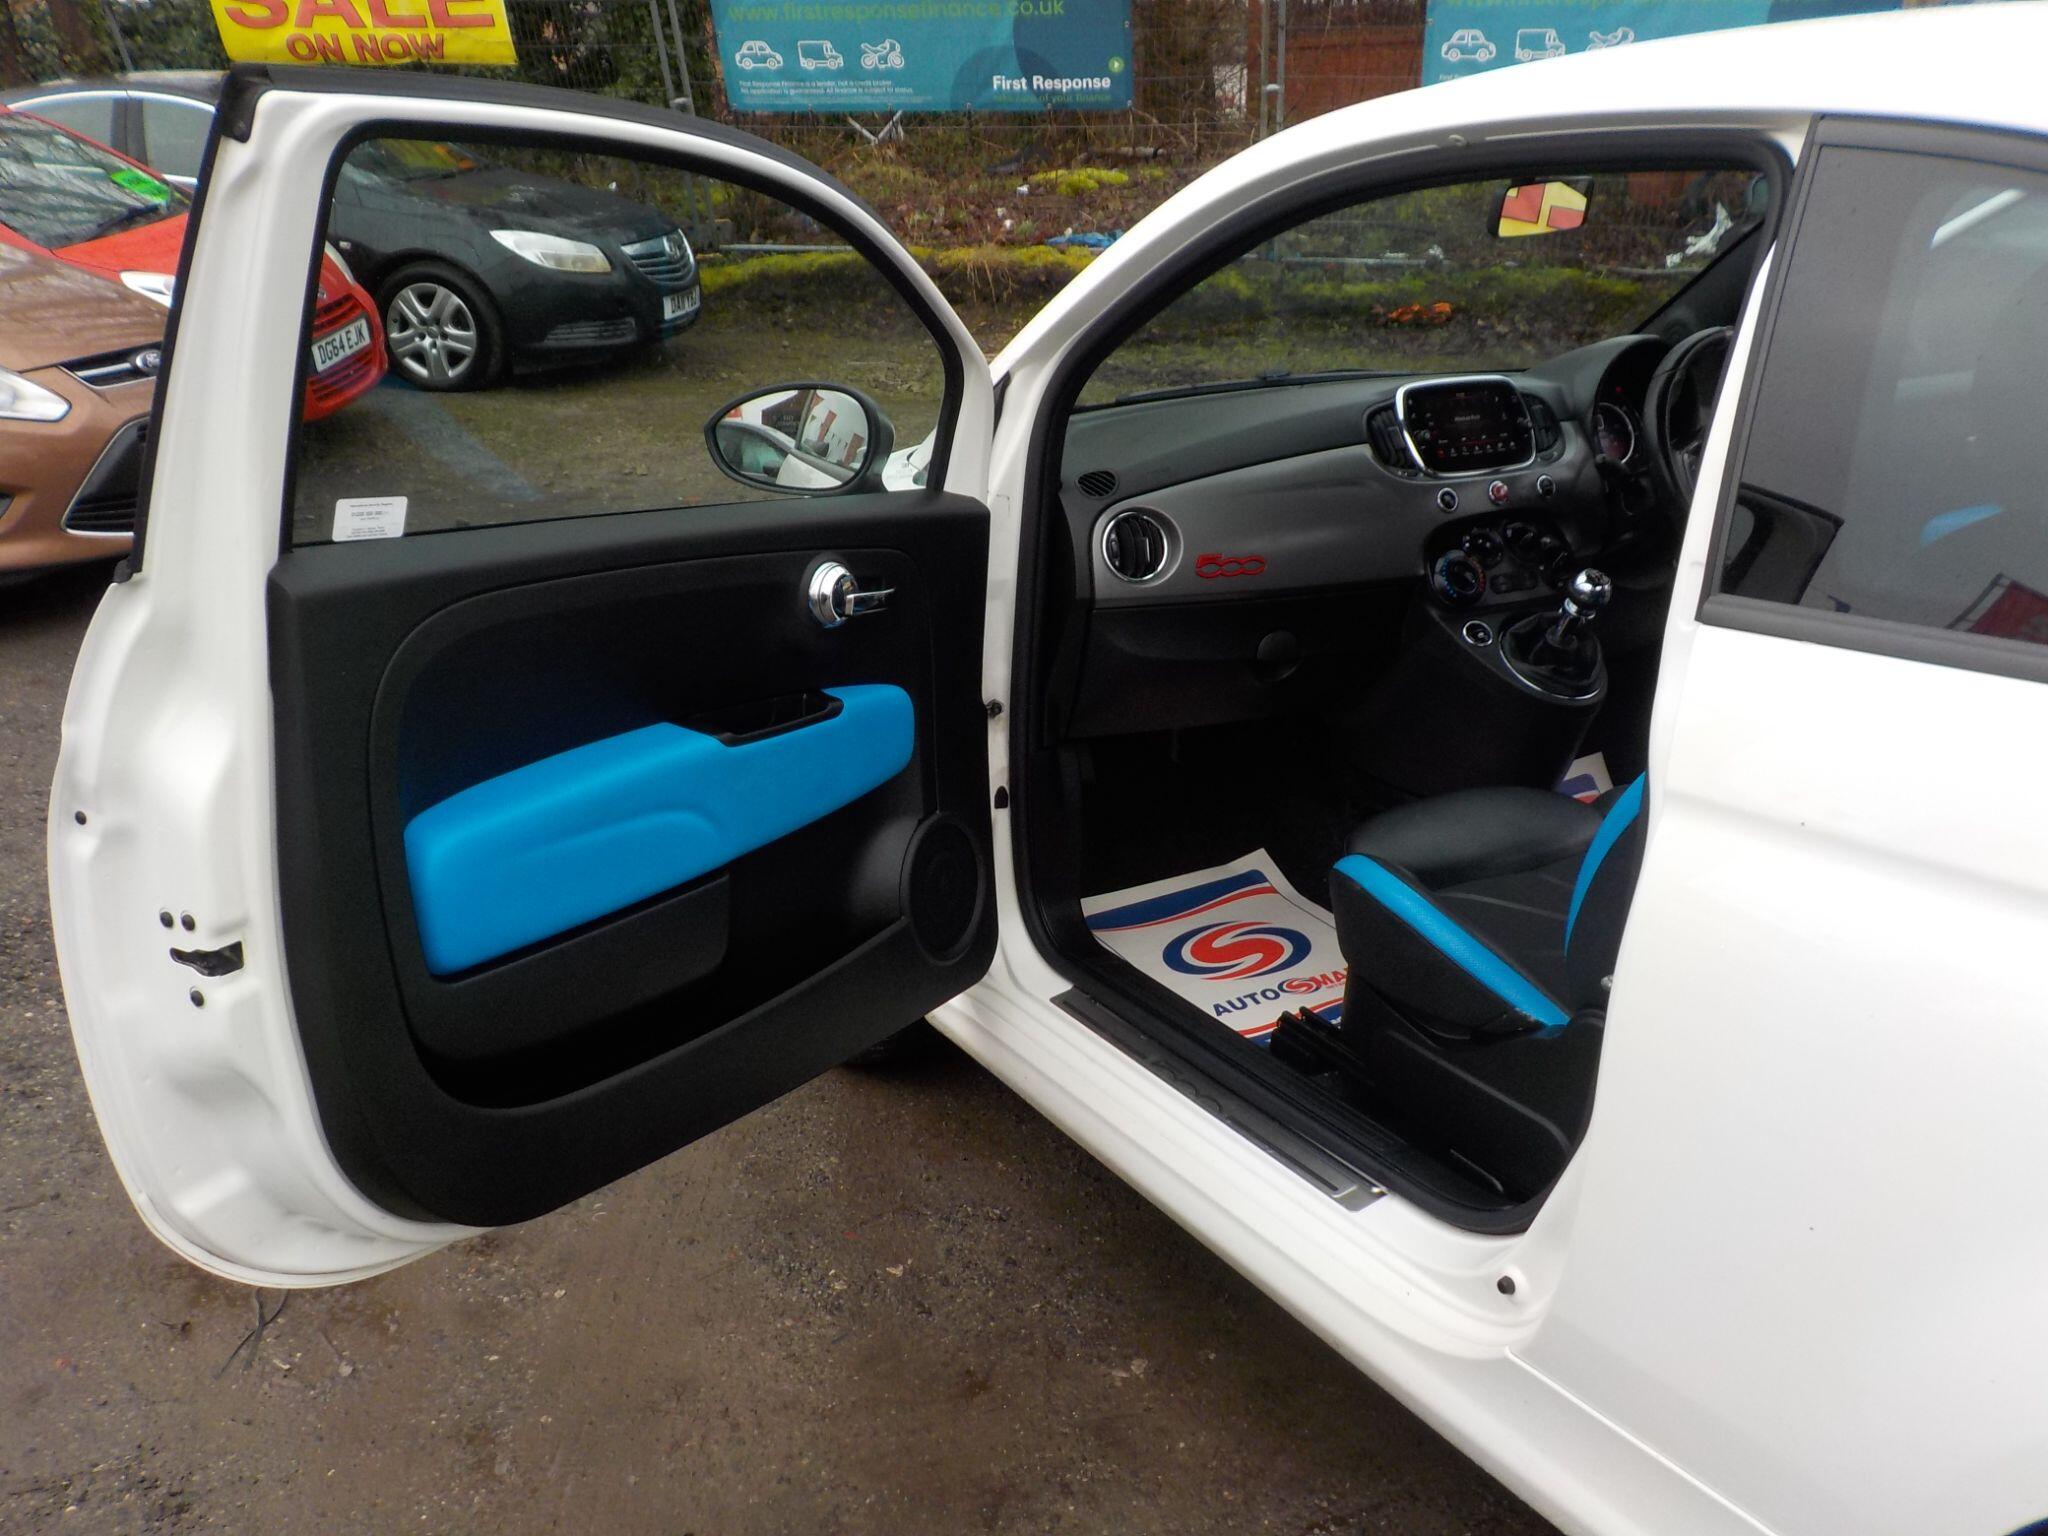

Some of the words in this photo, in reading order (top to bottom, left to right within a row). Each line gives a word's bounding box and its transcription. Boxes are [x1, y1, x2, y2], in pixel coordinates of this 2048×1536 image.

[286, 32, 347, 64] ON
[351, 32, 444, 63] NOW
[992, 75, 1028, 90] First
[1032, 75, 1111, 92] Response
[317, 333, 346, 364] DG64
[345, 323, 366, 350] EJK
[1196, 553, 1264, 578] 500
